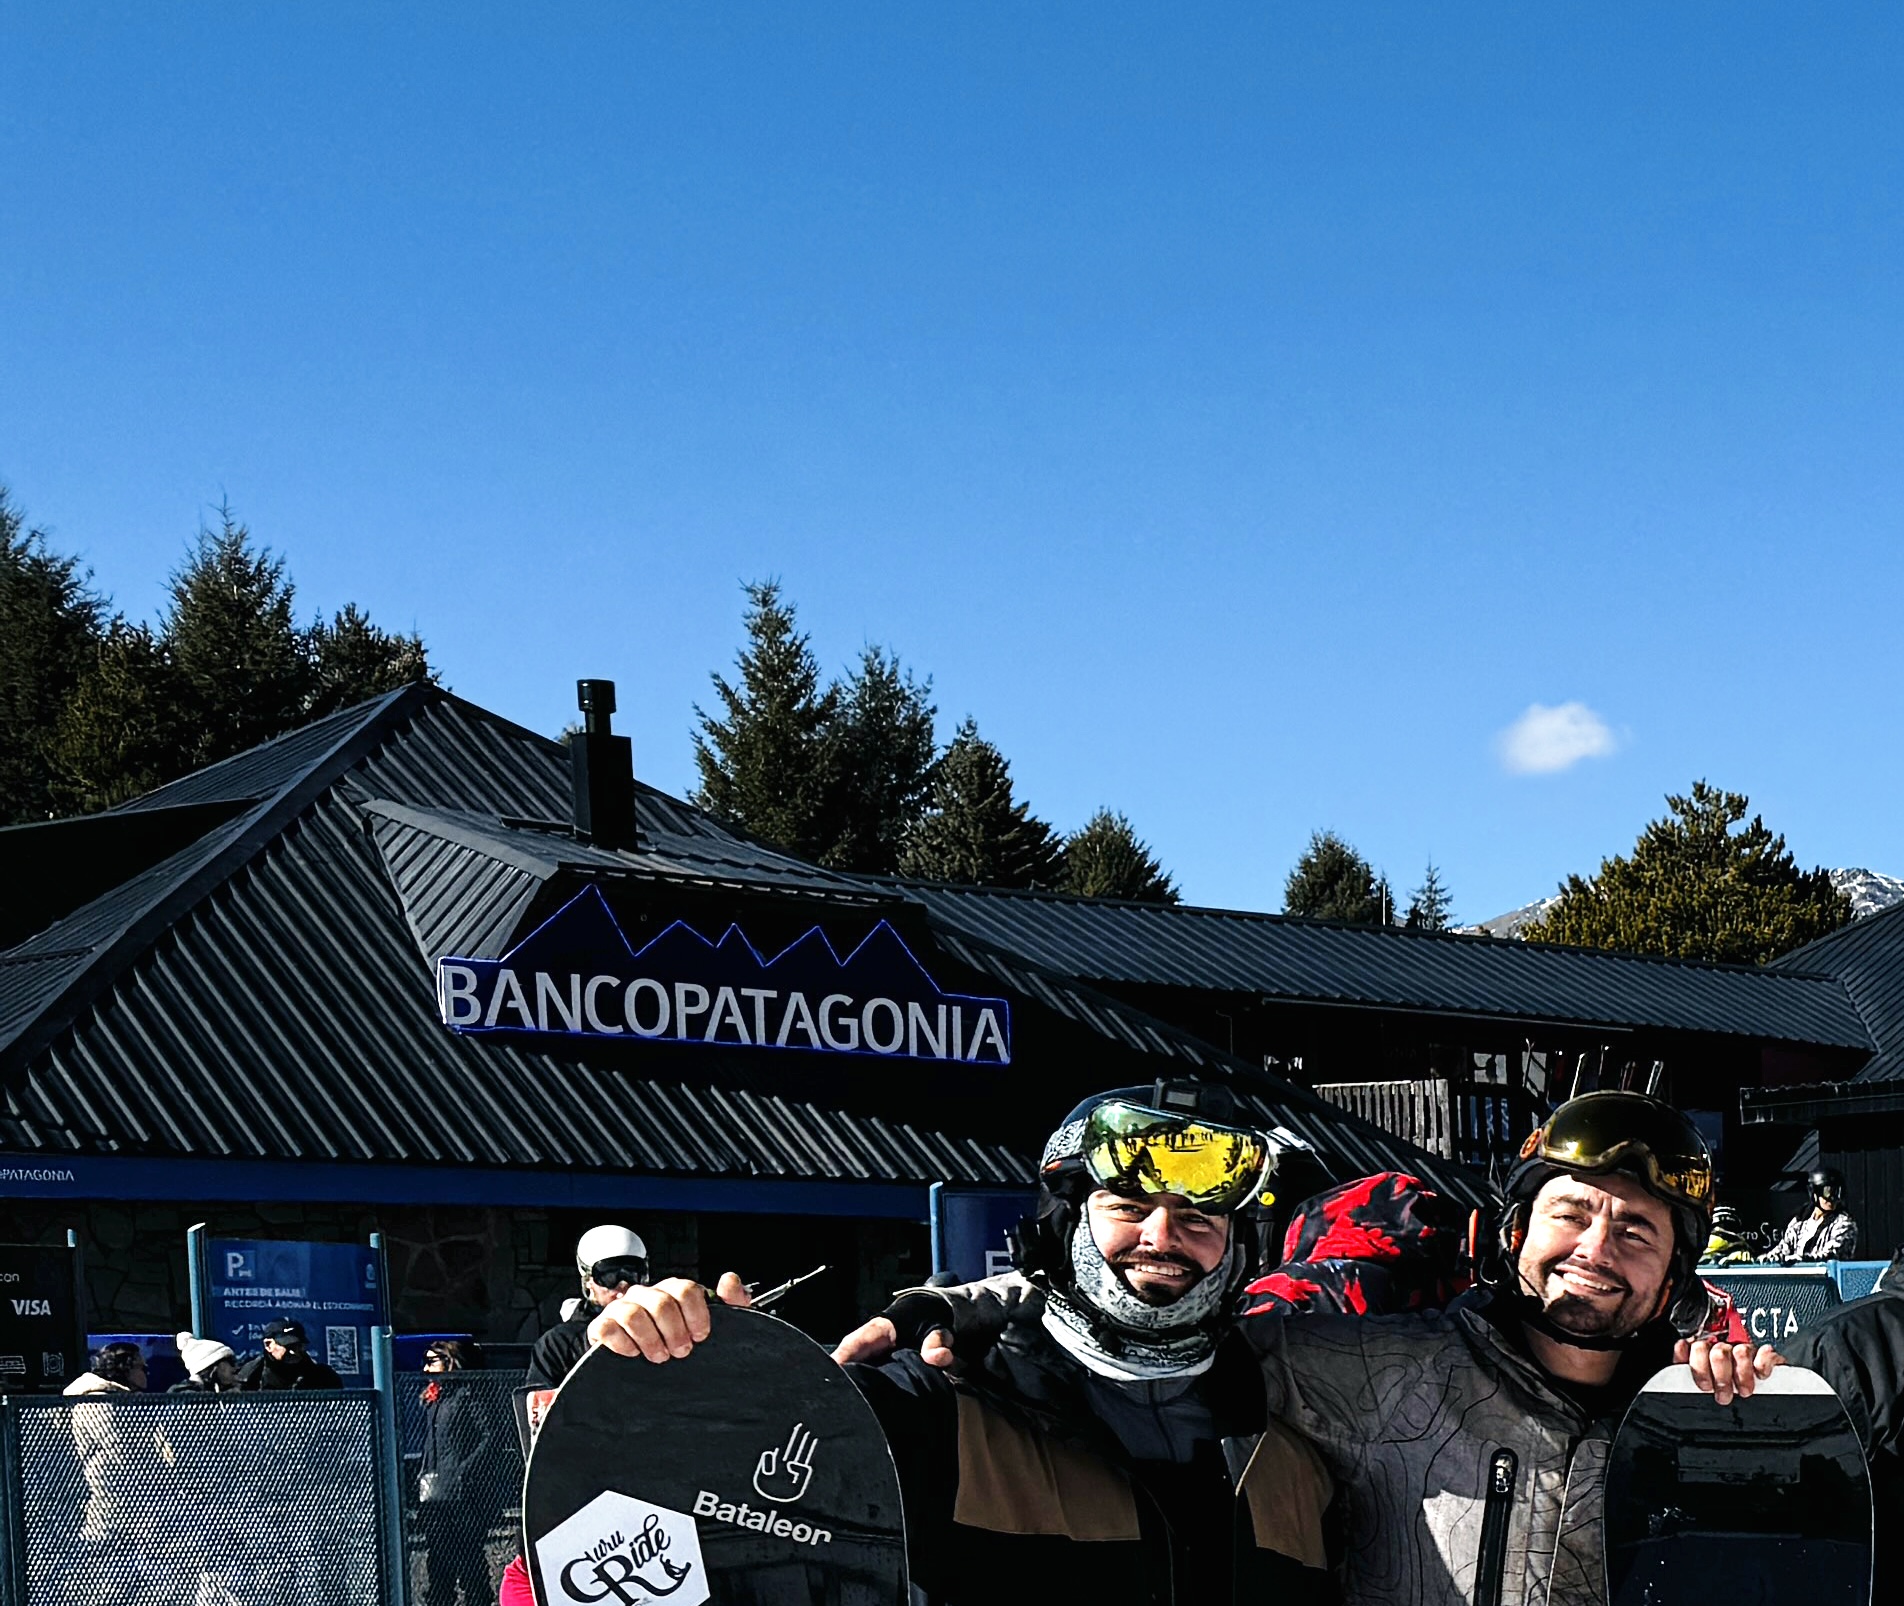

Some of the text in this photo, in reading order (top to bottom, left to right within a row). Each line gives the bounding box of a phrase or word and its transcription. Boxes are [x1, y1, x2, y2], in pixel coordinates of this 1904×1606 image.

[442, 964, 1009, 1063] BANCOPATAGONIA
[11, 1299, 52, 1316] VISA
[692, 1489, 832, 1546] Bataleon
